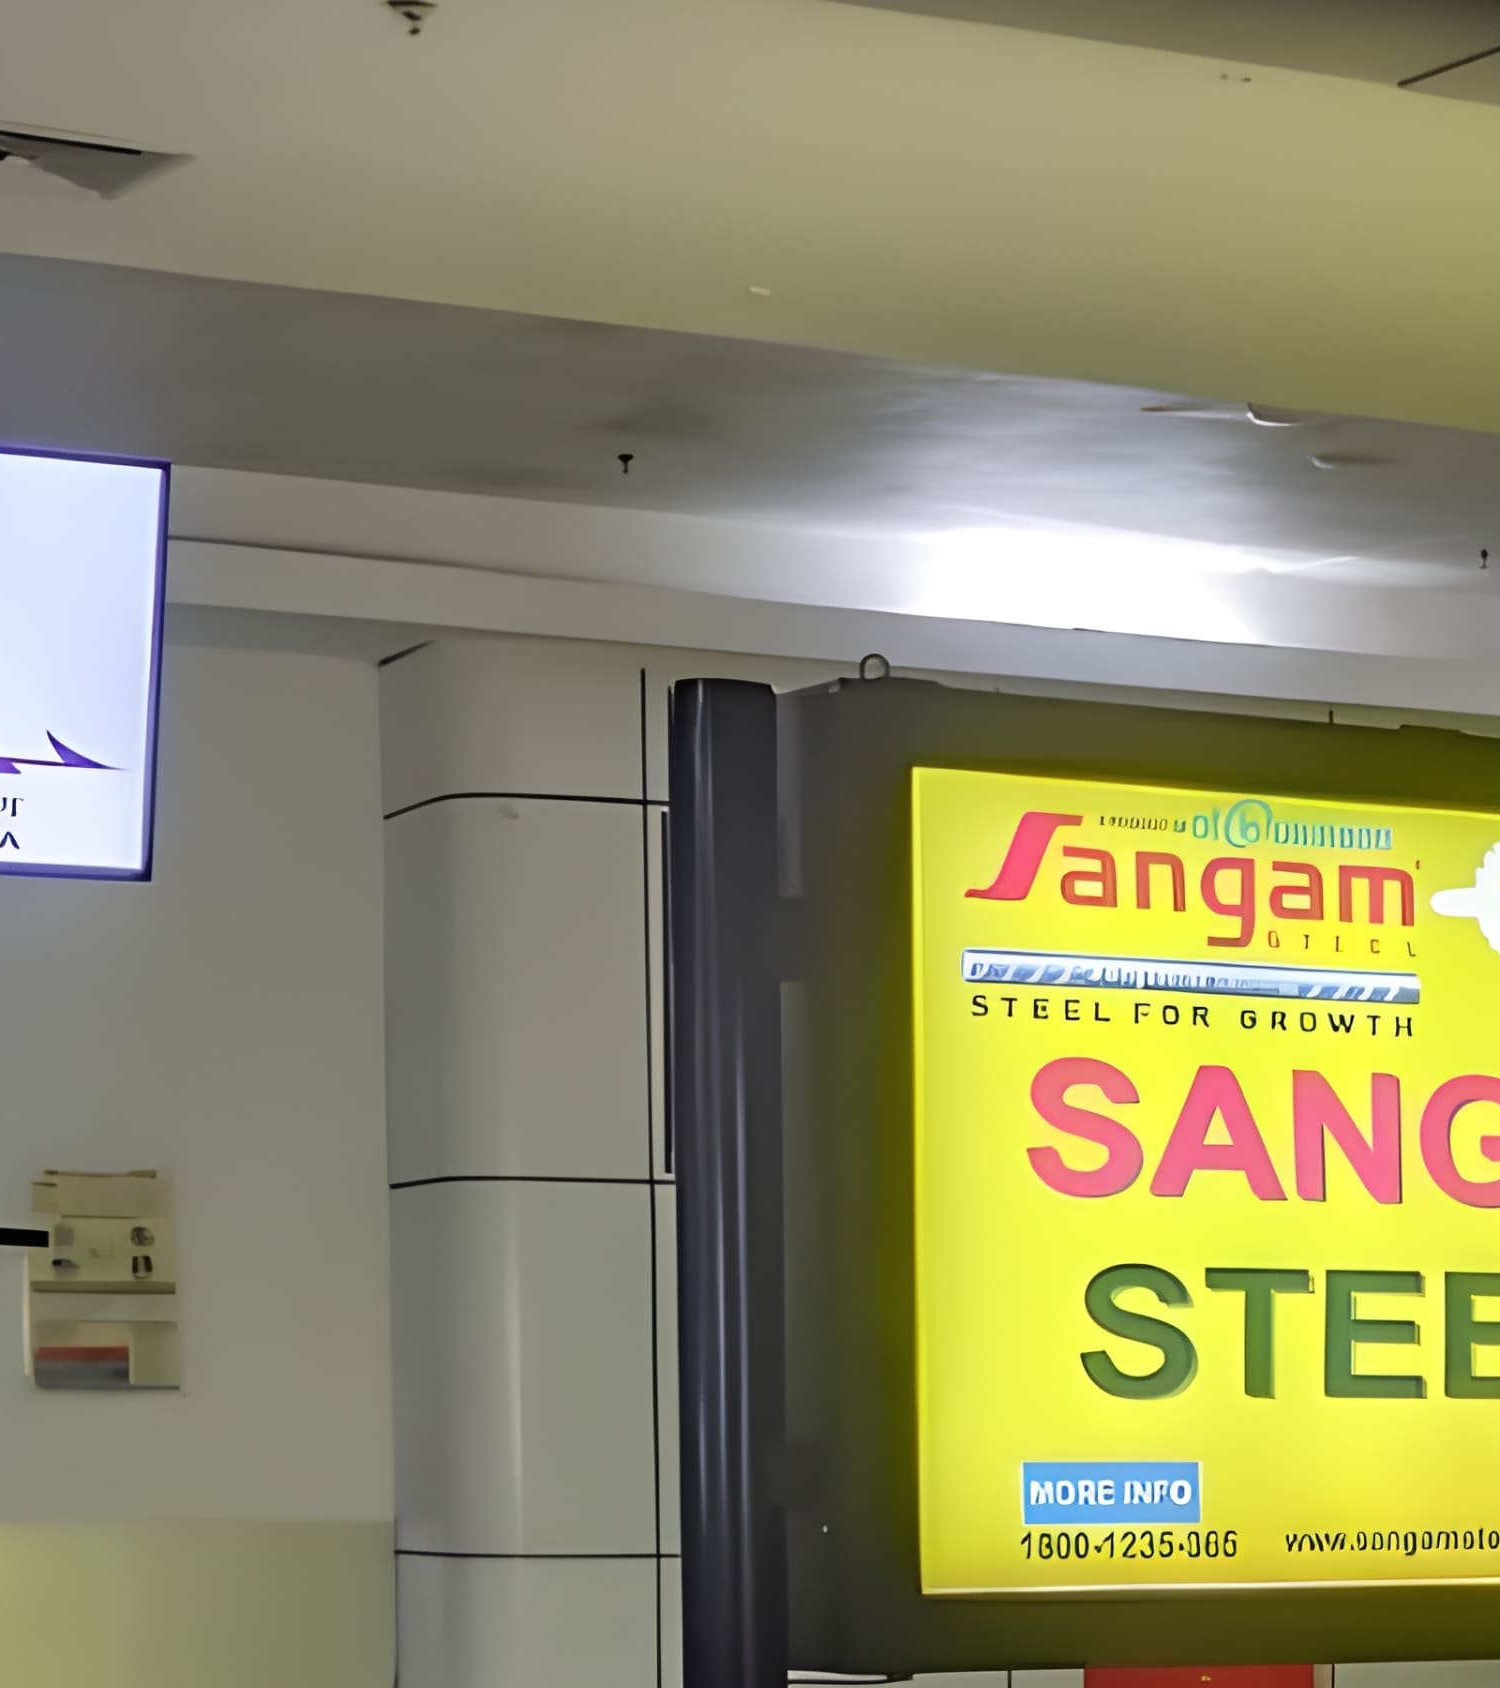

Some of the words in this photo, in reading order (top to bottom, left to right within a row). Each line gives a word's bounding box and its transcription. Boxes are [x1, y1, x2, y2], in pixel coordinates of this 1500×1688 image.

[964, 811, 1416, 947] Sangam
[971, 995, 1111, 1023] STEEL
[1134, 1002, 1211, 1028] FOR
[1240, 1008, 1414, 1037] GROWTH
[1029, 1479, 1116, 1505] MORE
[1123, 1479, 1193, 1505] INFO
